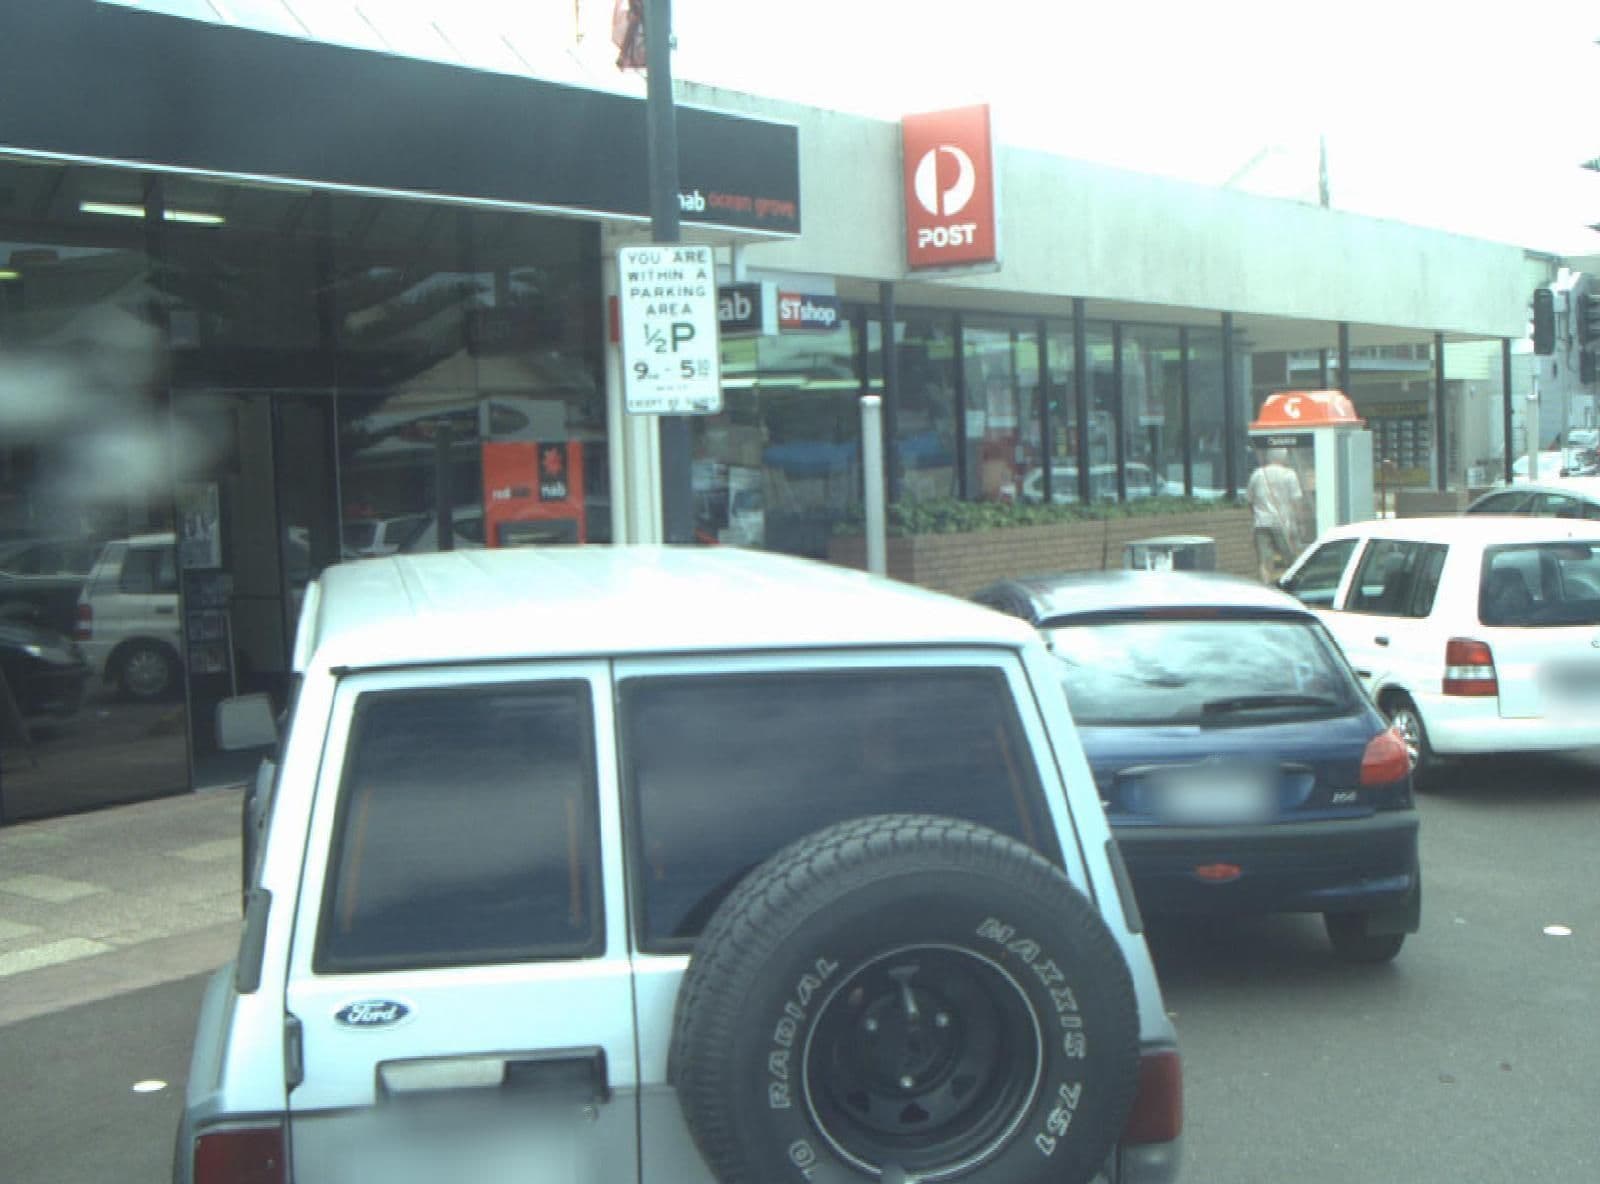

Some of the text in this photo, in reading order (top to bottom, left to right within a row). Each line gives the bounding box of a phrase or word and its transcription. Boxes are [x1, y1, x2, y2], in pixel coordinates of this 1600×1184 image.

[918, 223, 977, 248] POST
[627, 249, 706, 265] YOU ARE
[627, 268, 707, 281] WITHIN A
[629, 286, 706, 298] PARKING
[645, 303, 693, 316] AREA
[345, 1001, 401, 1024] Ford
[768, 957, 840, 1110] RADIAL
[976, 917, 1087, 1157] MAXXIS 751
